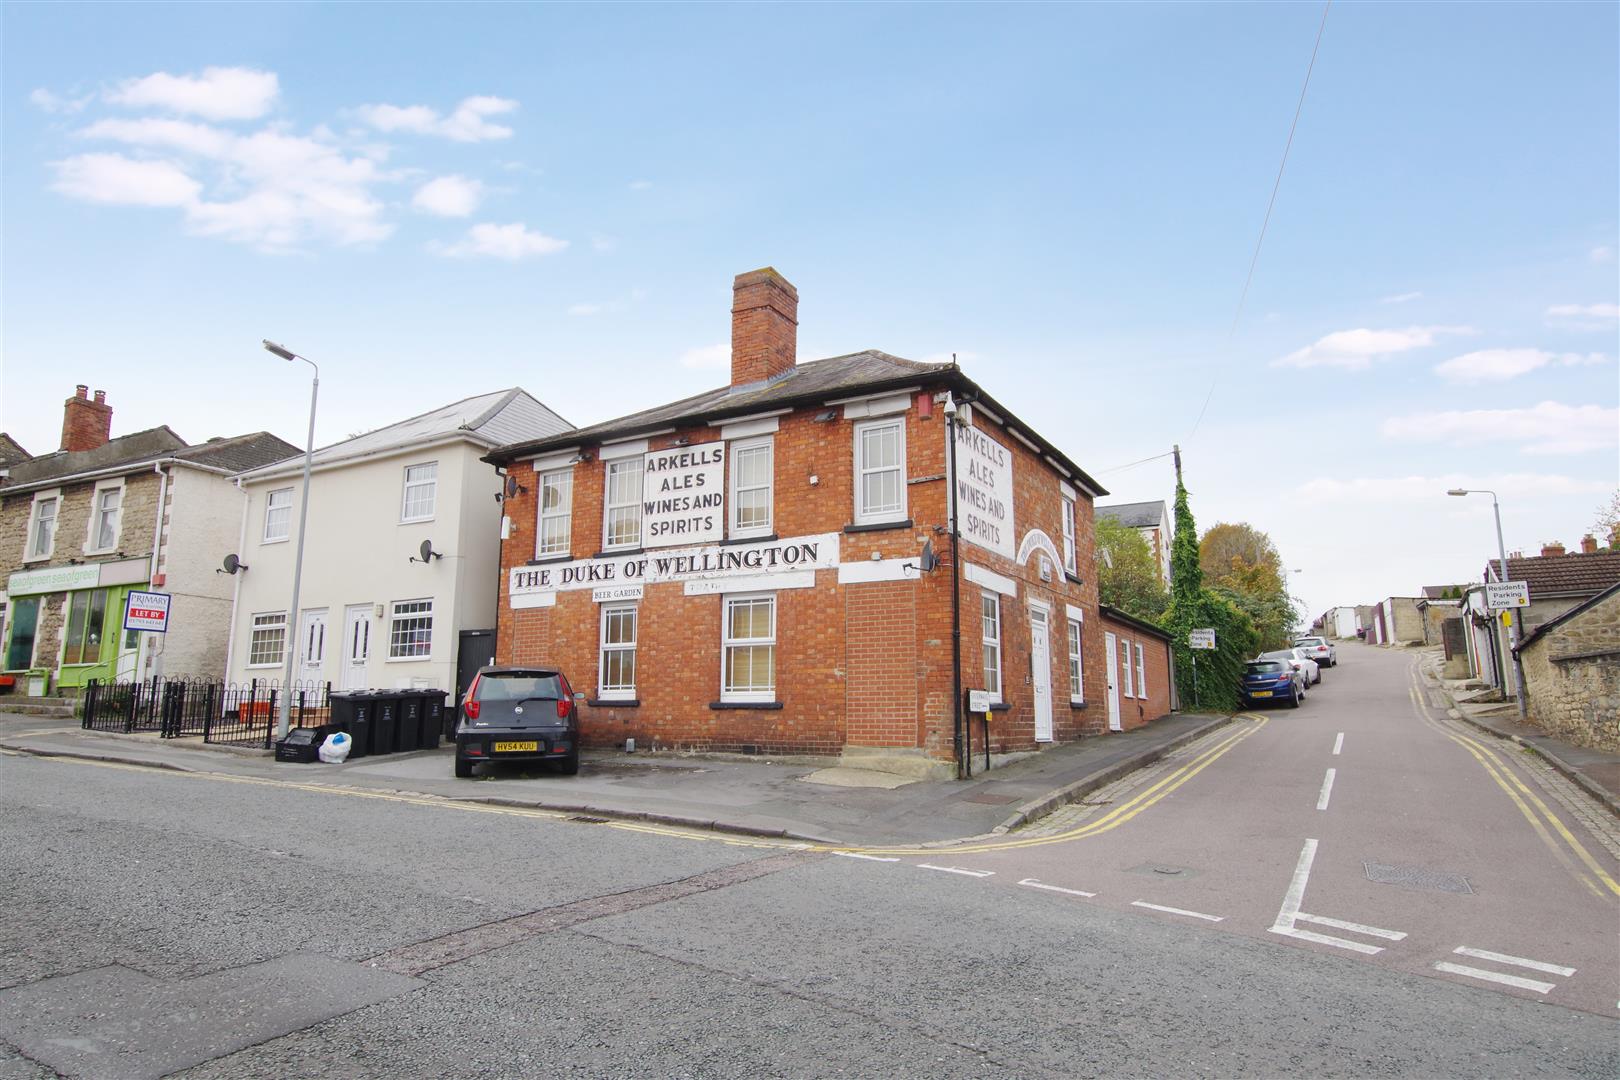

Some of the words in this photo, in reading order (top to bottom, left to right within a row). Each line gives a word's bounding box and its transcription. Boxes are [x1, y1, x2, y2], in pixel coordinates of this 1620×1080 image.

[958, 426, 1004, 468] ARKELLS
[646, 449, 723, 473] ARKELLS
[660, 472, 706, 492] ALES
[970, 458, 995, 488] ALES
[643, 496, 690, 516] WINES
[692, 493, 722, 510] AND
[958, 479, 987, 512] WINES
[988, 497, 1005, 521] AND
[650, 515, 713, 536] SPIRITS
[967, 513, 1000, 545] SPIRITS
[515, 569, 551, 589] THE
[560, 562, 616, 584] DUKE
[624, 560, 649, 578] OF
[655, 542, 820, 577] WELLINGTON
[131, 594, 168, 605] PRIMARY
[594, 591, 612, 600] BEER
[614, 588, 642, 598] GARDEN
[135, 609, 148, 617] LET
